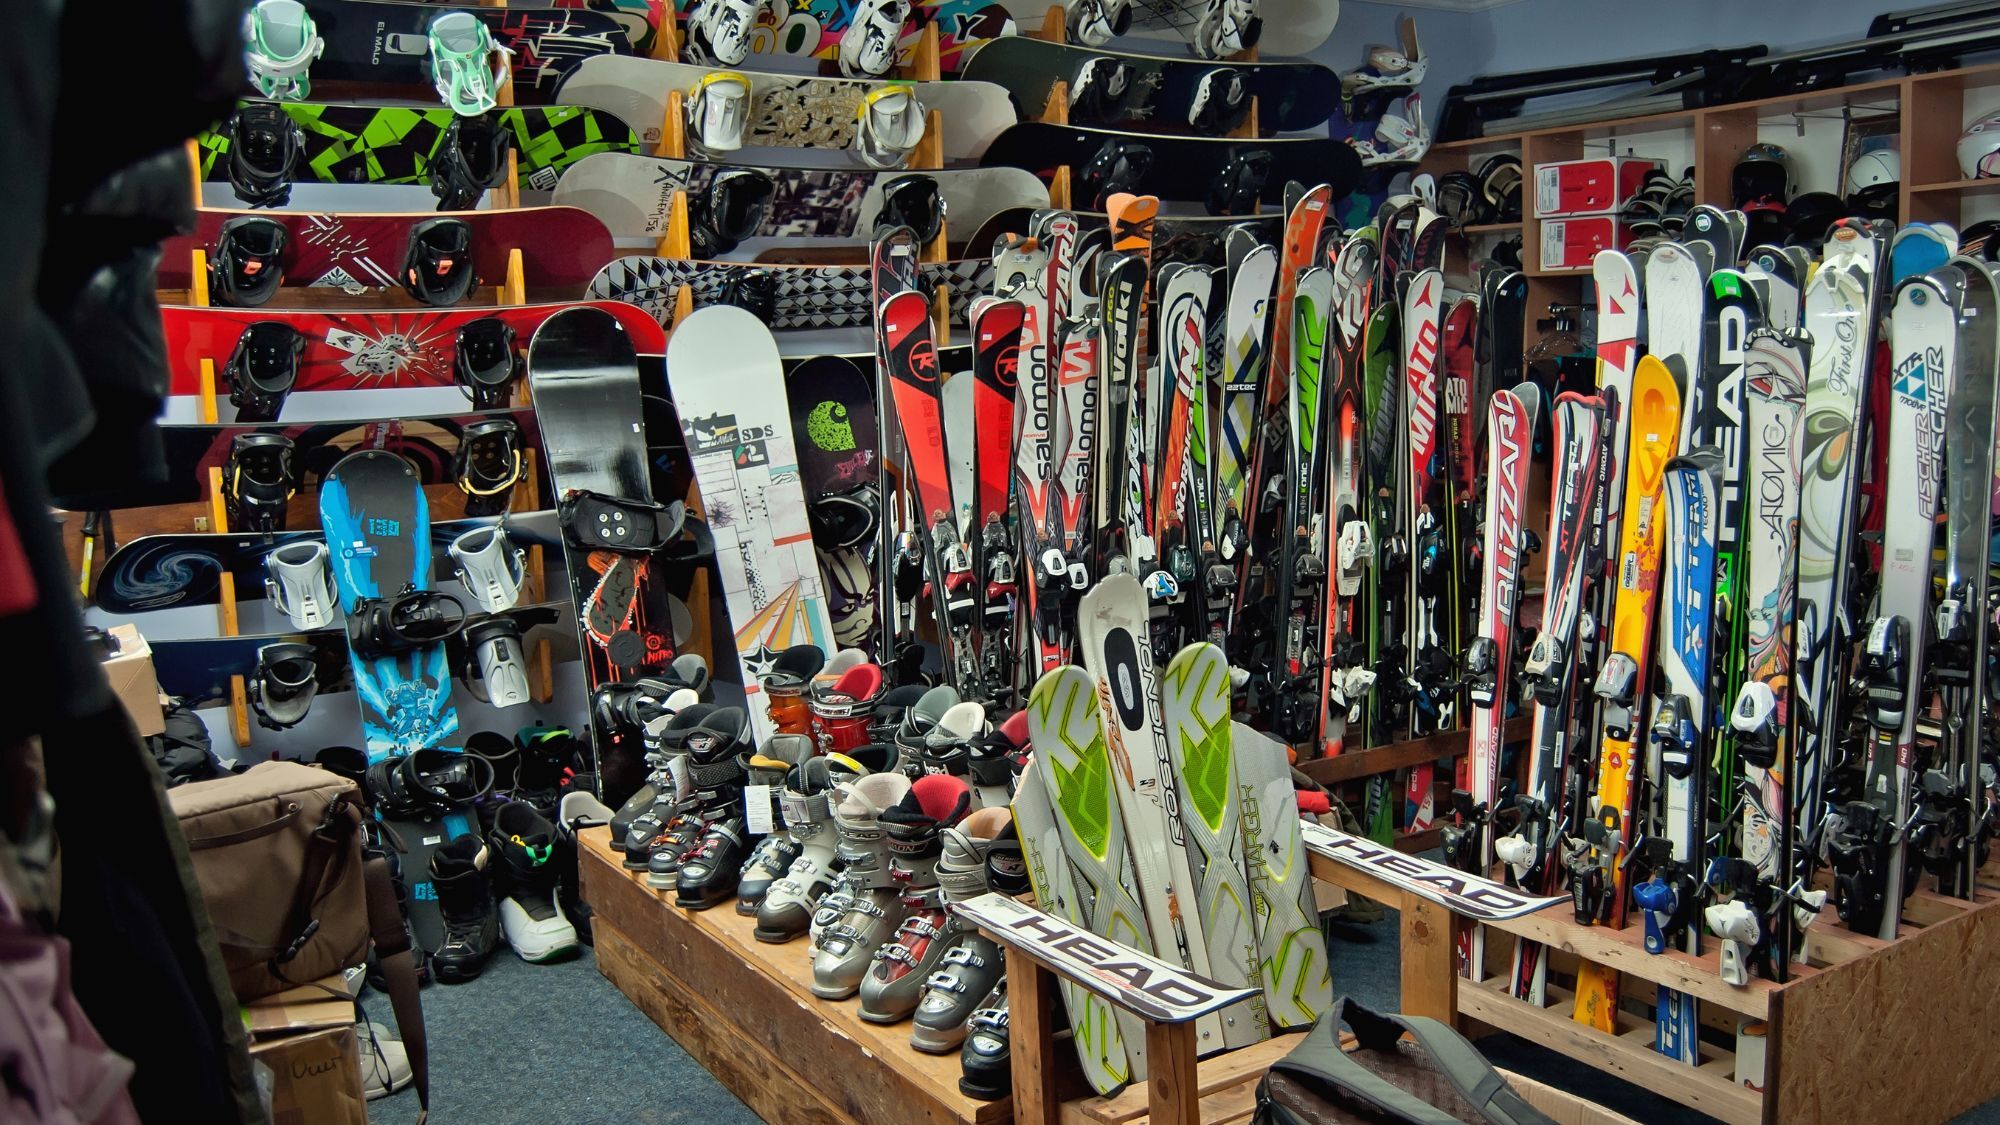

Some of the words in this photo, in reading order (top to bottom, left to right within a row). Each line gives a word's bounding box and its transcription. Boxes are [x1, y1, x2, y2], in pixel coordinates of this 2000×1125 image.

[376, 21, 386, 35] EL
[371, 37, 385, 66] MALO
[1445, 377, 1467, 398] ATO
[1446, 393, 1468, 415] MIC
[1899, 395, 1927, 411] motive
[1030, 344, 1052, 482] salomon
[1717, 305, 1746, 542] HEAD
[741, 424, 775, 442] SDS
[1075, 376, 1098, 495] salomon
[1599, 444, 1609, 481] ATOMIC
[1914, 412, 1934, 521] FISCHER
[1701, 495, 1709, 530] TECNO
[646, 649, 674, 664] NITRO
[1137, 619, 1187, 848] ROSSIGNOL
[1327, 838, 1528, 910] HEAD
[1010, 915, 1215, 1008] HEAD
